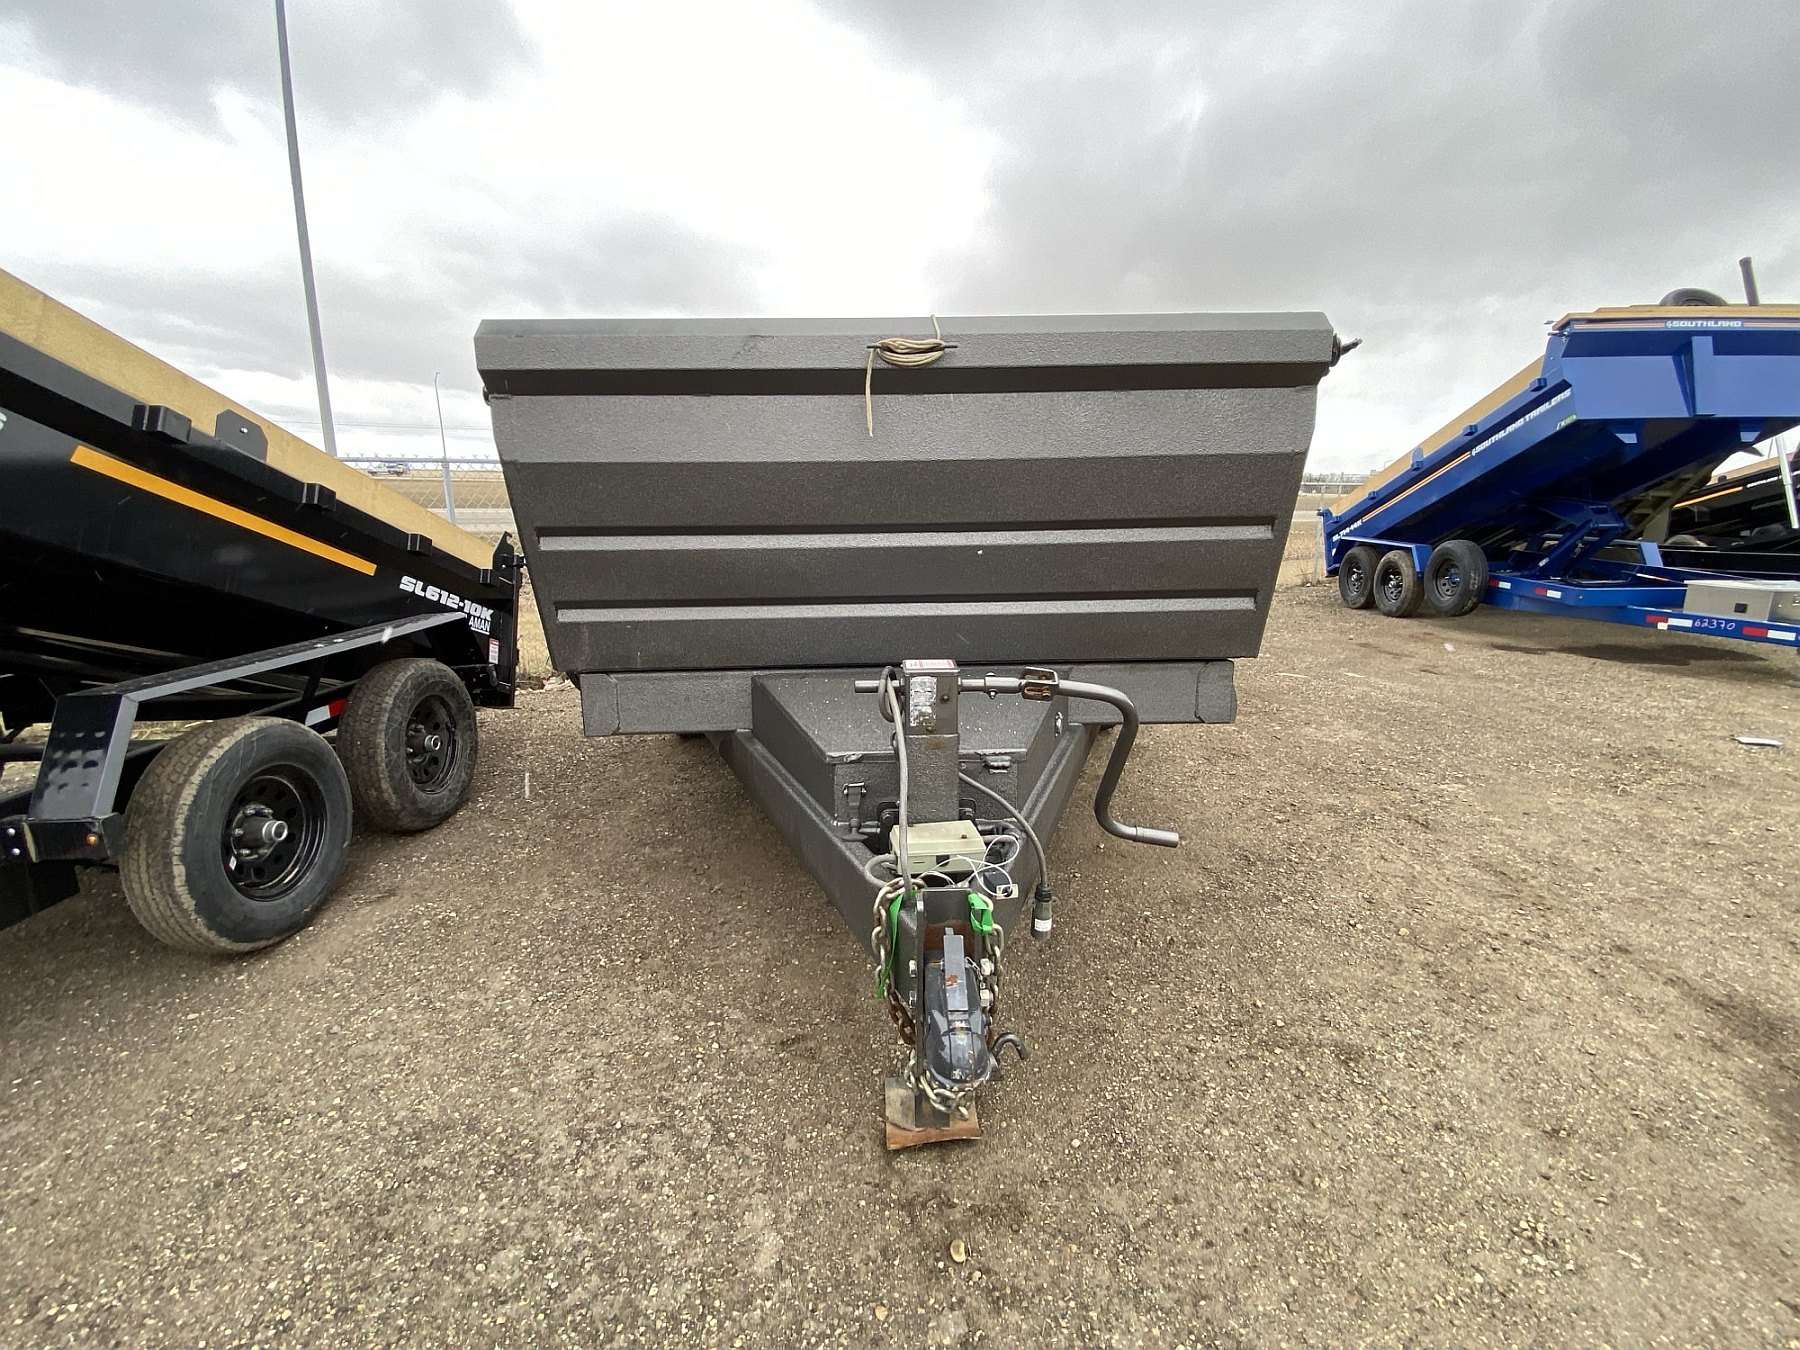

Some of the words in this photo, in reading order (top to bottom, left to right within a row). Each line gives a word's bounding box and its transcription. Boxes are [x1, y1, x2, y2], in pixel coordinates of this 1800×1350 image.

[1671, 320, 1742, 328] SOUTHLAND
[1474, 418, 1525, 454] SOUTHLAND
[1525, 388, 1572, 422] TRAILERS
[399, 575, 494, 621] SL612-10K
